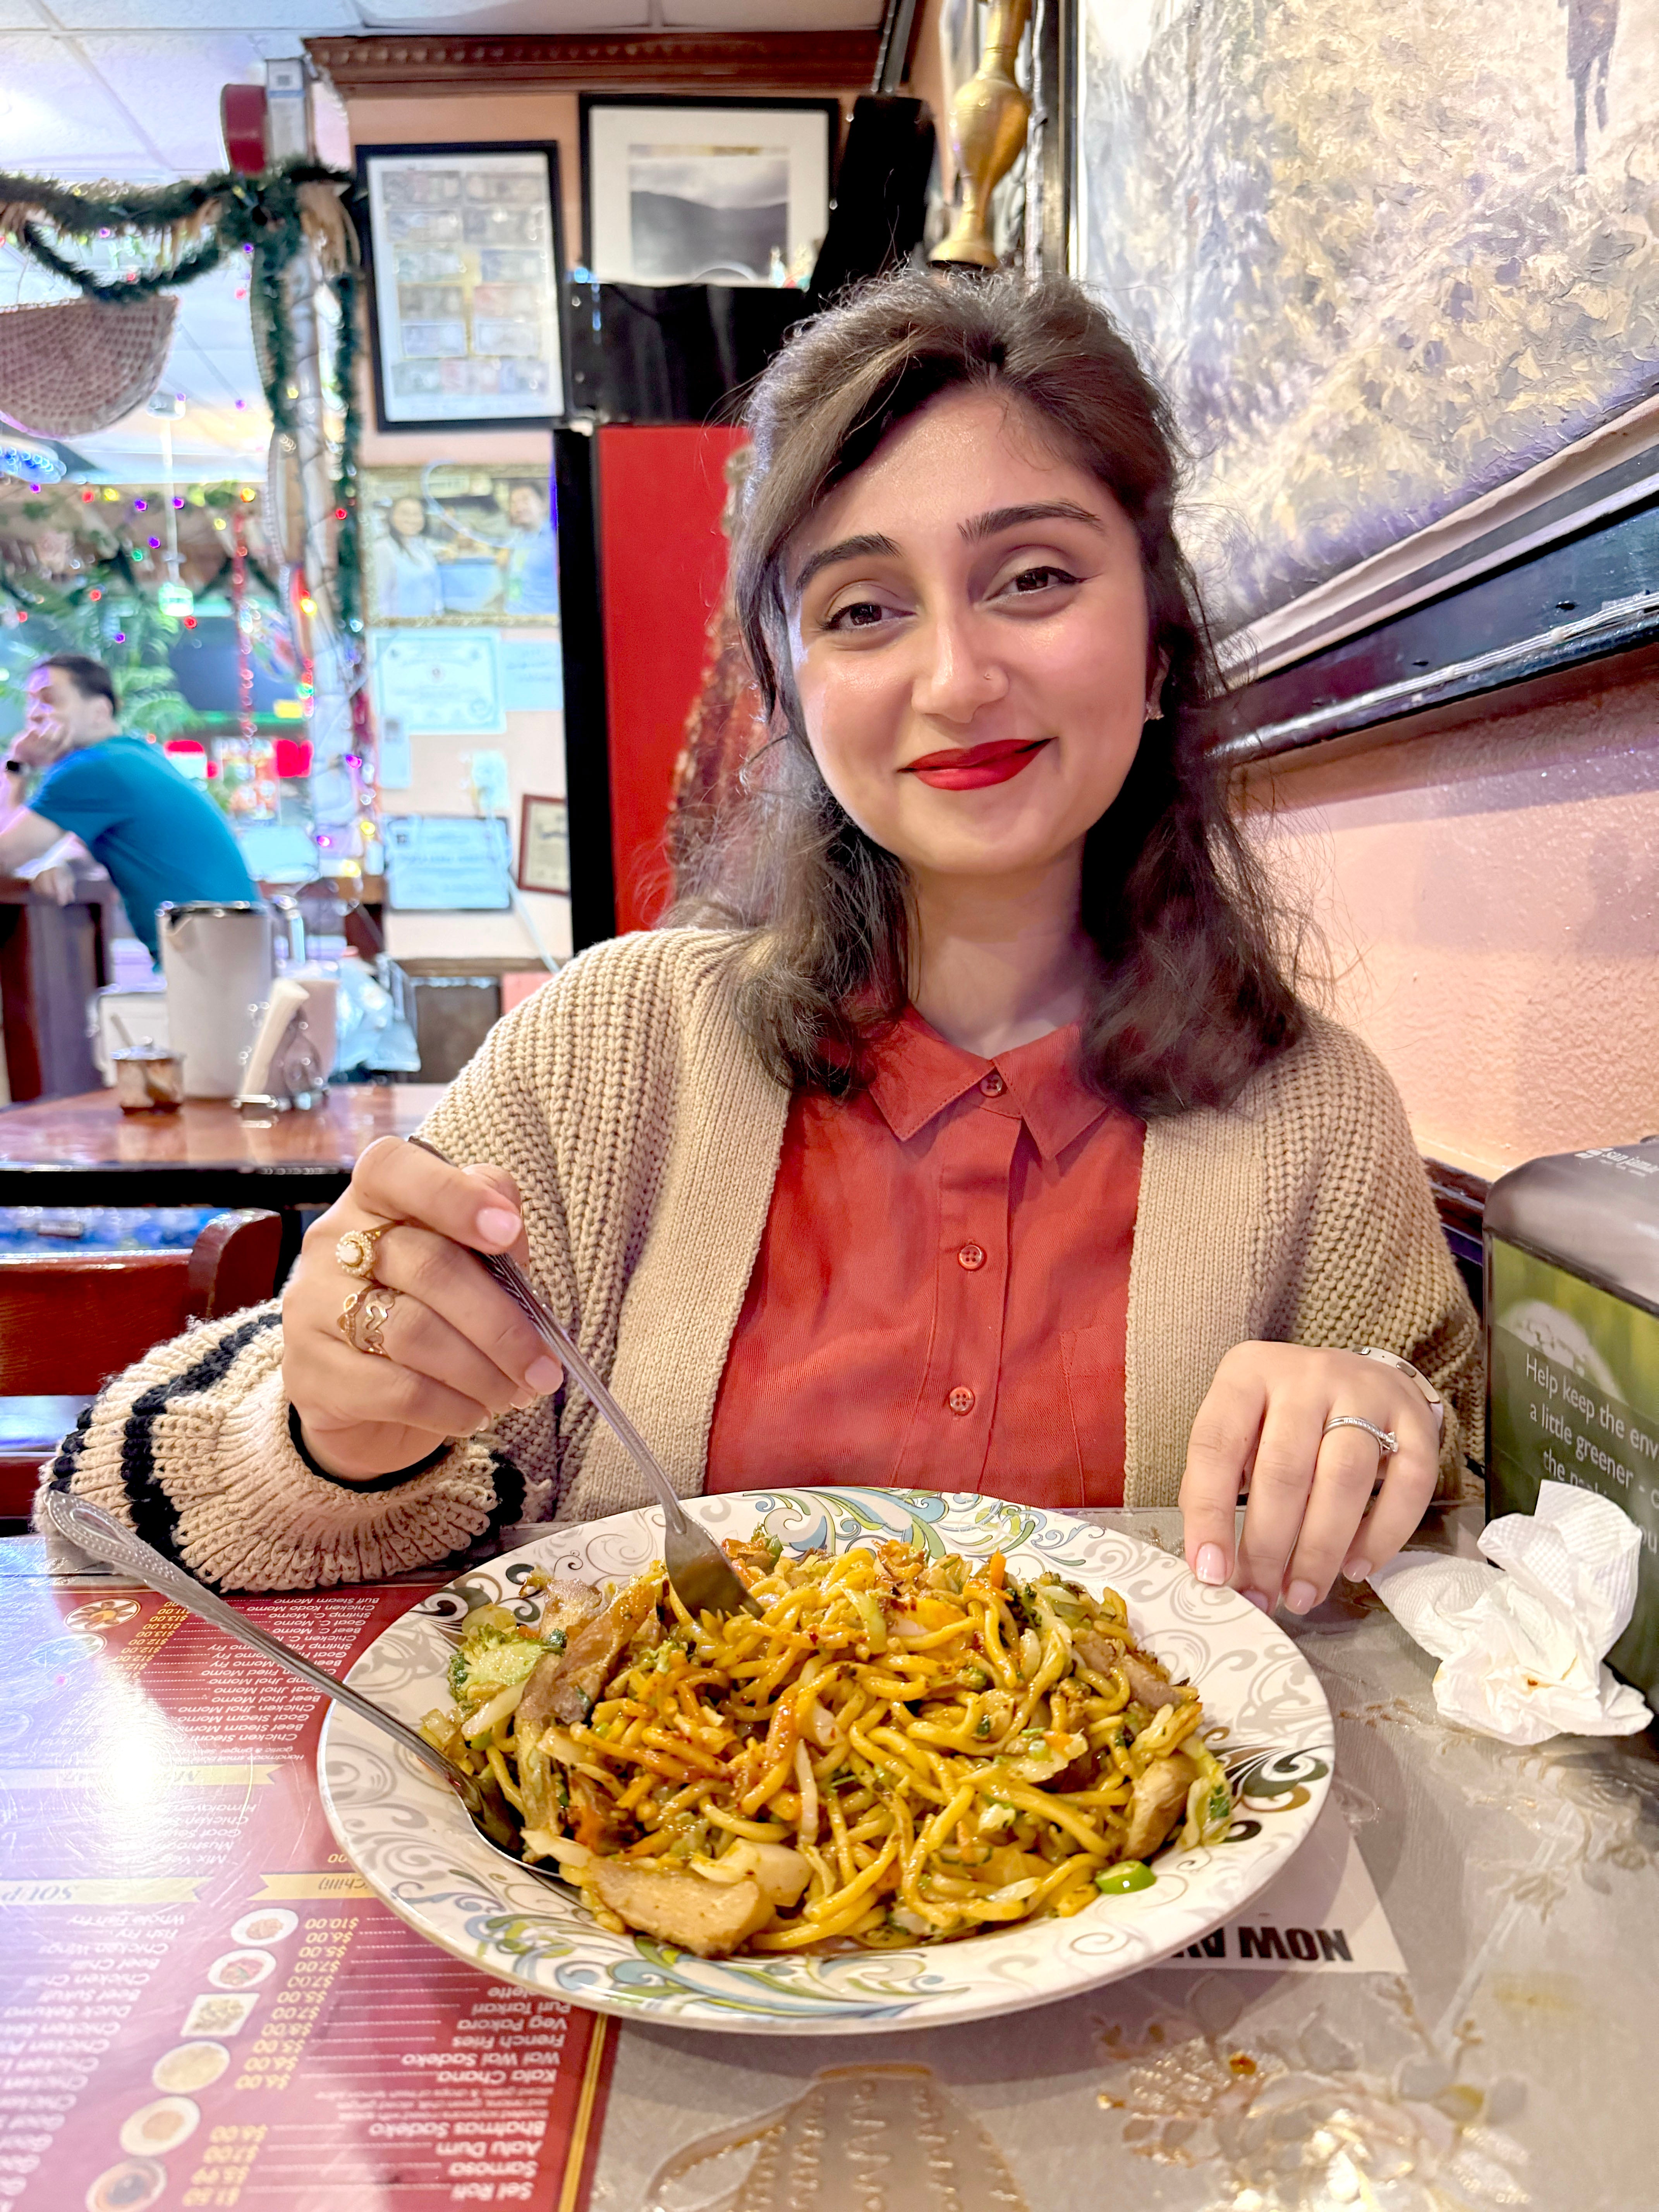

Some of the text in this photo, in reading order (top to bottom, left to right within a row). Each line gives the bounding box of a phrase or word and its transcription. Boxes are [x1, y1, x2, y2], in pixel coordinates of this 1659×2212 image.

[1527, 1353, 1659, 1461] Help keep the env
[1530, 1403, 1537, 1422] a
[1542, 1403, 1572, 1445] little
[1576, 1436, 1633, 1489] greener
[1544, 1448, 1565, 1481] the
[227, 1714, 271, 1722] Steam
[273, 1714, 309, 1722] Goat
[225, 1724, 270, 1732] Steam
[271, 1723, 304, 1731] Beef
[191, 1734, 236, 1742] Steam
[239, 1733, 298, 1741] Chicken
[171, 1803, 257, 1812] Hmalayan
[198, 1828, 242, 1838] Goat
[1, 1885, 73, 1902] SOUP
[305, 1917, 359, 1930] $10.00
[306, 1930, 353, 1944] $6.00
[1238, 1927, 1353, 1961] NOW
[95, 1942, 169, 1955] Chicken
[298, 1945, 347, 1958] $5.00
[116, 1958, 160, 1970] Beef
[294, 1960, 340, 1973] $7.00
[73, 1973, 150, 1987] Chicken
[287, 1975, 334, 1989] $7.00
[277, 1990, 327, 2004] $5.00
[81, 2005, 131, 2019] Duck
[271, 2001, 571, 2020] Puri Tarkari $7.00
[457, 2018, 525, 2032] Pakora
[528, 2015, 567, 2030] Veg
[452, 2035, 495, 2049] Fries
[500, 2034, 565, 2048] French
[401, 2053, 478, 2067] Sadeko
[481, 2052, 518, 2066] Wai
[522, 2051, 560, 2064] Wai
[437, 2070, 506, 2085] Chana
[511, 2069, 557, 2083] Kala
[368, 2122, 450, 2138] Sadeko
[453, 2120, 546, 2137] Bhatmas
[435, 2141, 487, 2158] Dum
[490, 2140, 543, 2157] Aalu
[448, 2160, 538, 2179] Samosa
